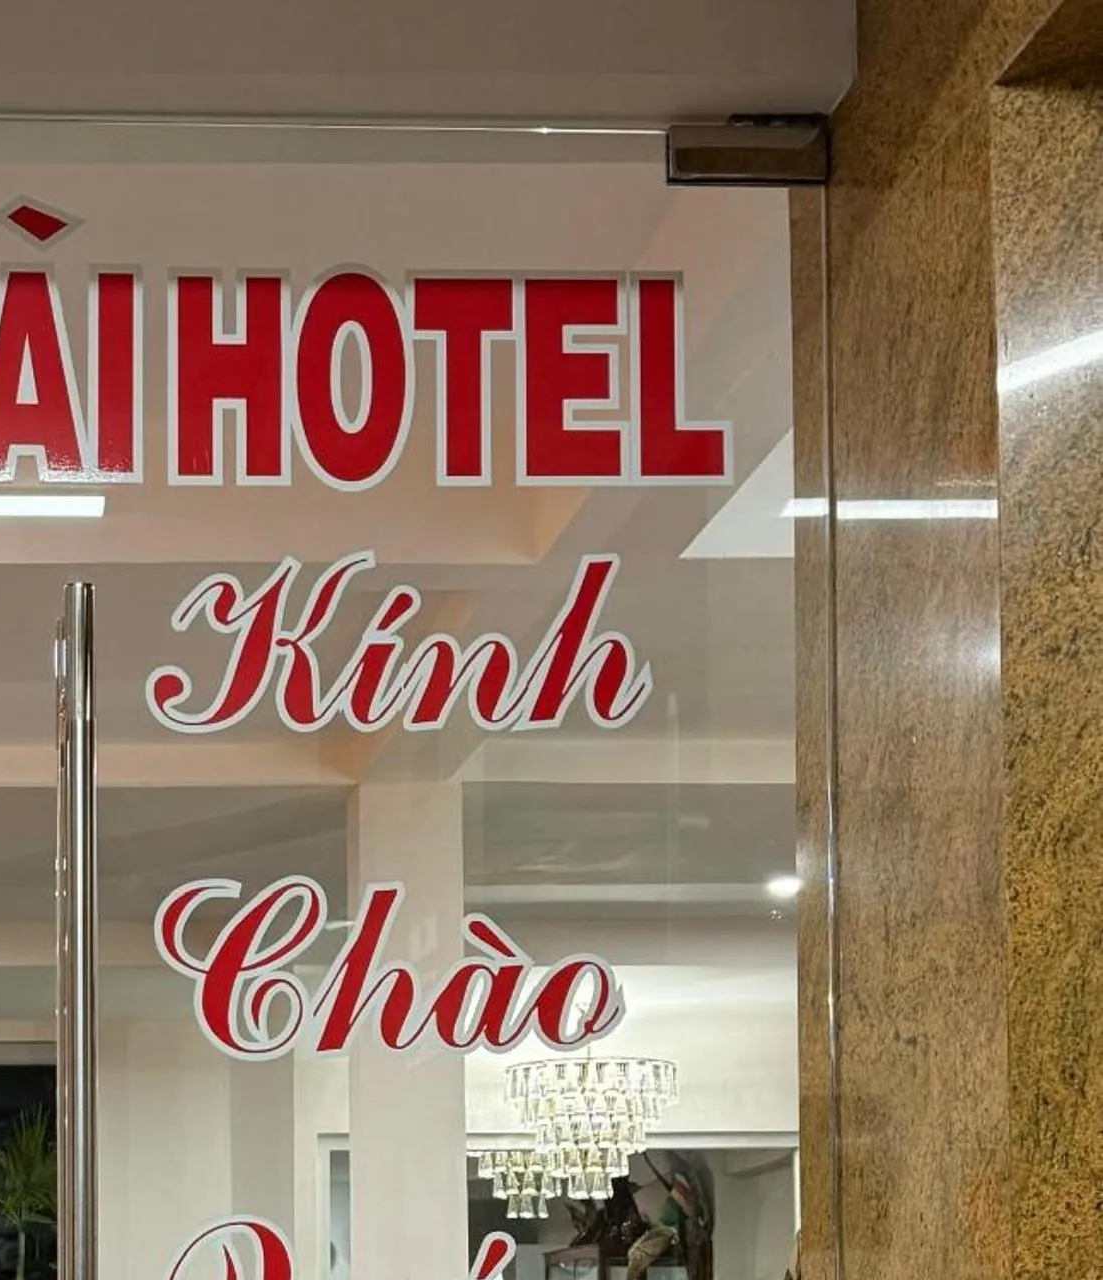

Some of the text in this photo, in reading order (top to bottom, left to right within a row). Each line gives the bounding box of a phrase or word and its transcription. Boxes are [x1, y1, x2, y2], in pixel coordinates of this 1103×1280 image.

[168, 262, 735, 491] HOTEL
[146, 551, 653, 733] Kính
[154, 875, 627, 1061] Chào
